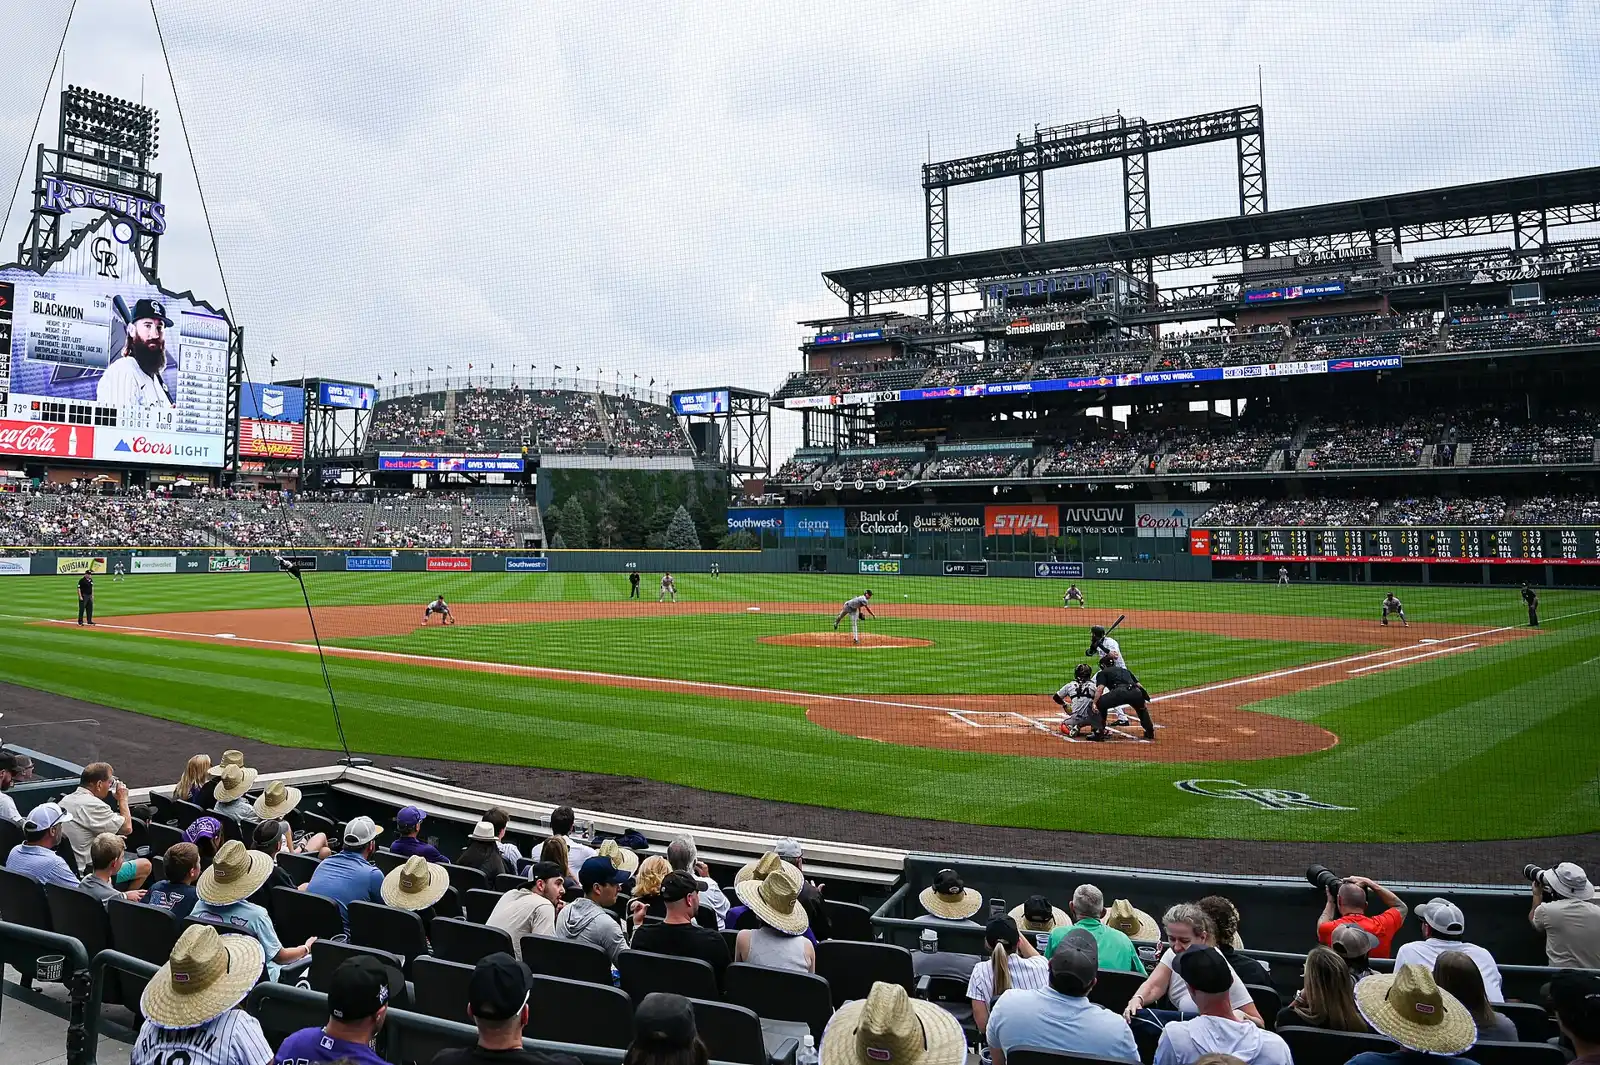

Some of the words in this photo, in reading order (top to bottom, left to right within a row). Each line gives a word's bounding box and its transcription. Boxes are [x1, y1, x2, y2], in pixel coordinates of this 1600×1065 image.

[45, 178, 166, 233] ROCKIES
[1314, 251, 1336, 261] JACK
[1496, 268, 1540, 282] Silver
[34, 290, 56, 300] CHARLIE
[34, 301, 83, 319] BLACKMON
[94, 300, 100, 308] 19
[1354, 356, 1400, 368] EMPOWER
[14, 404, 28, 414] 73°
[252, 423, 292, 441] KING
[133, 436, 172, 455] Coors
[174, 444, 208, 457] LIGHT
[860, 510, 886, 522] Bank
[888, 510, 899, 521] of
[994, 514, 1049, 528] STIHL
[1066, 508, 1124, 522] ARROW
[1137, 513, 1179, 528] Coors
[728, 518, 775, 528] Southwest
[798, 519, 829, 532] cigna
[914, 515, 936, 528] BLUE
[954, 517, 980, 526] MOON
[860, 522, 908, 534] Colorado
[1066, 526, 1082, 534] Five
[1084, 526, 1105, 534] Years
[59, 561, 89, 573] LOUISIANA
[212, 560, 228, 569] TREE
[228, 559, 240, 567] TOP
[860, 562, 898, 572] bet365
